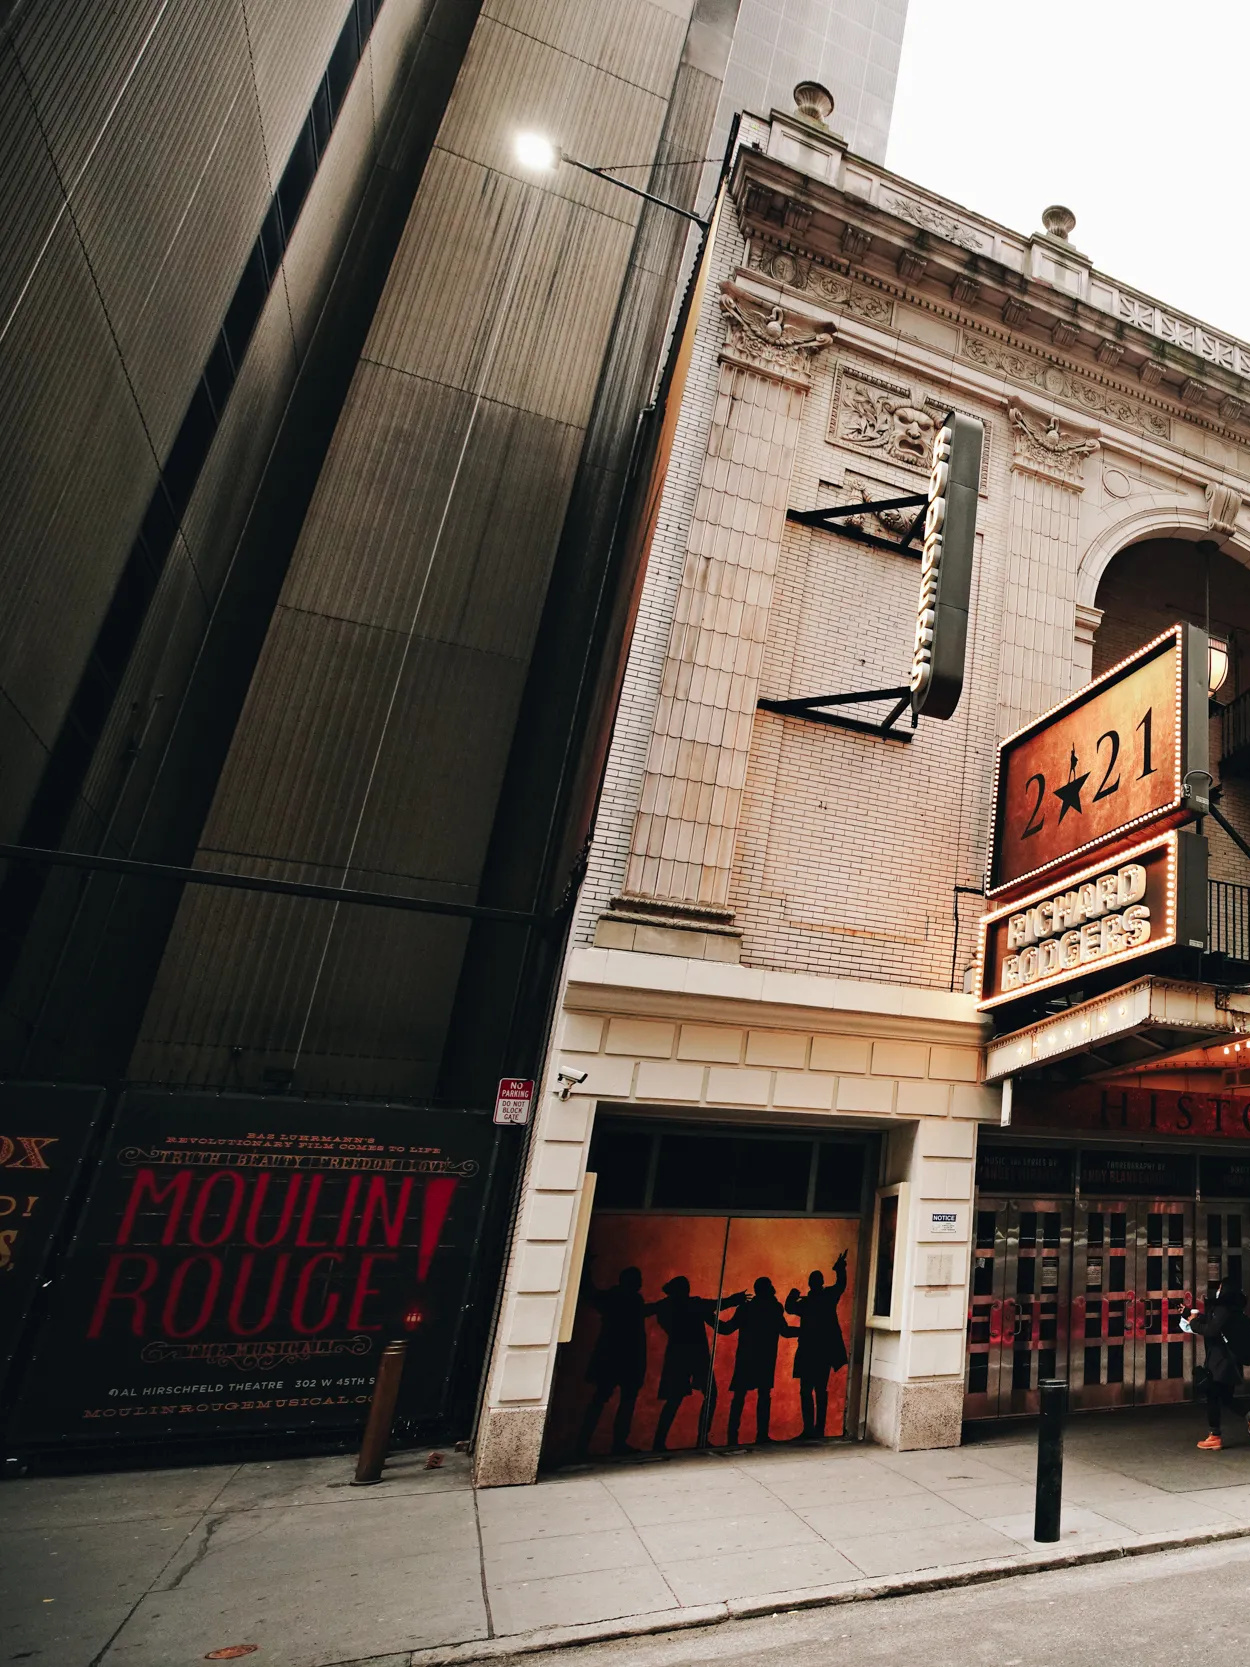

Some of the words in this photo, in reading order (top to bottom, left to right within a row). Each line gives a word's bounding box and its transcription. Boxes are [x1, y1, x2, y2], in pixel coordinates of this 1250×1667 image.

[1006, 863, 1147, 950] RICHARD
[1001, 905, 1152, 992] RODGERS
[501, 1089, 529, 1098] PARKING
[510, 1081, 524, 1090] NO
[503, 1113, 520, 1121] GATE
[165, 1136, 294, 1148] REVOLUTIONARY
[339, 1143, 384, 1151] COMES
[409, 1146, 441, 1154] LIFE
[158, 1150, 221, 1165] TRUTH
[237, 1153, 303, 1168] BEAUTY
[319, 1156, 395, 1171] FREEDOM
[142, 1384, 224, 1396] HIRSCHFELD
[228, 1381, 284, 1391] THEATRE
[295, 1379, 317, 1388] 302
[321, 1378, 333, 1387] W
[336, 1377, 365, 1386] 45TH
[82, 1395, 373, 1419] MOULINROUGEMUSICAL.C
